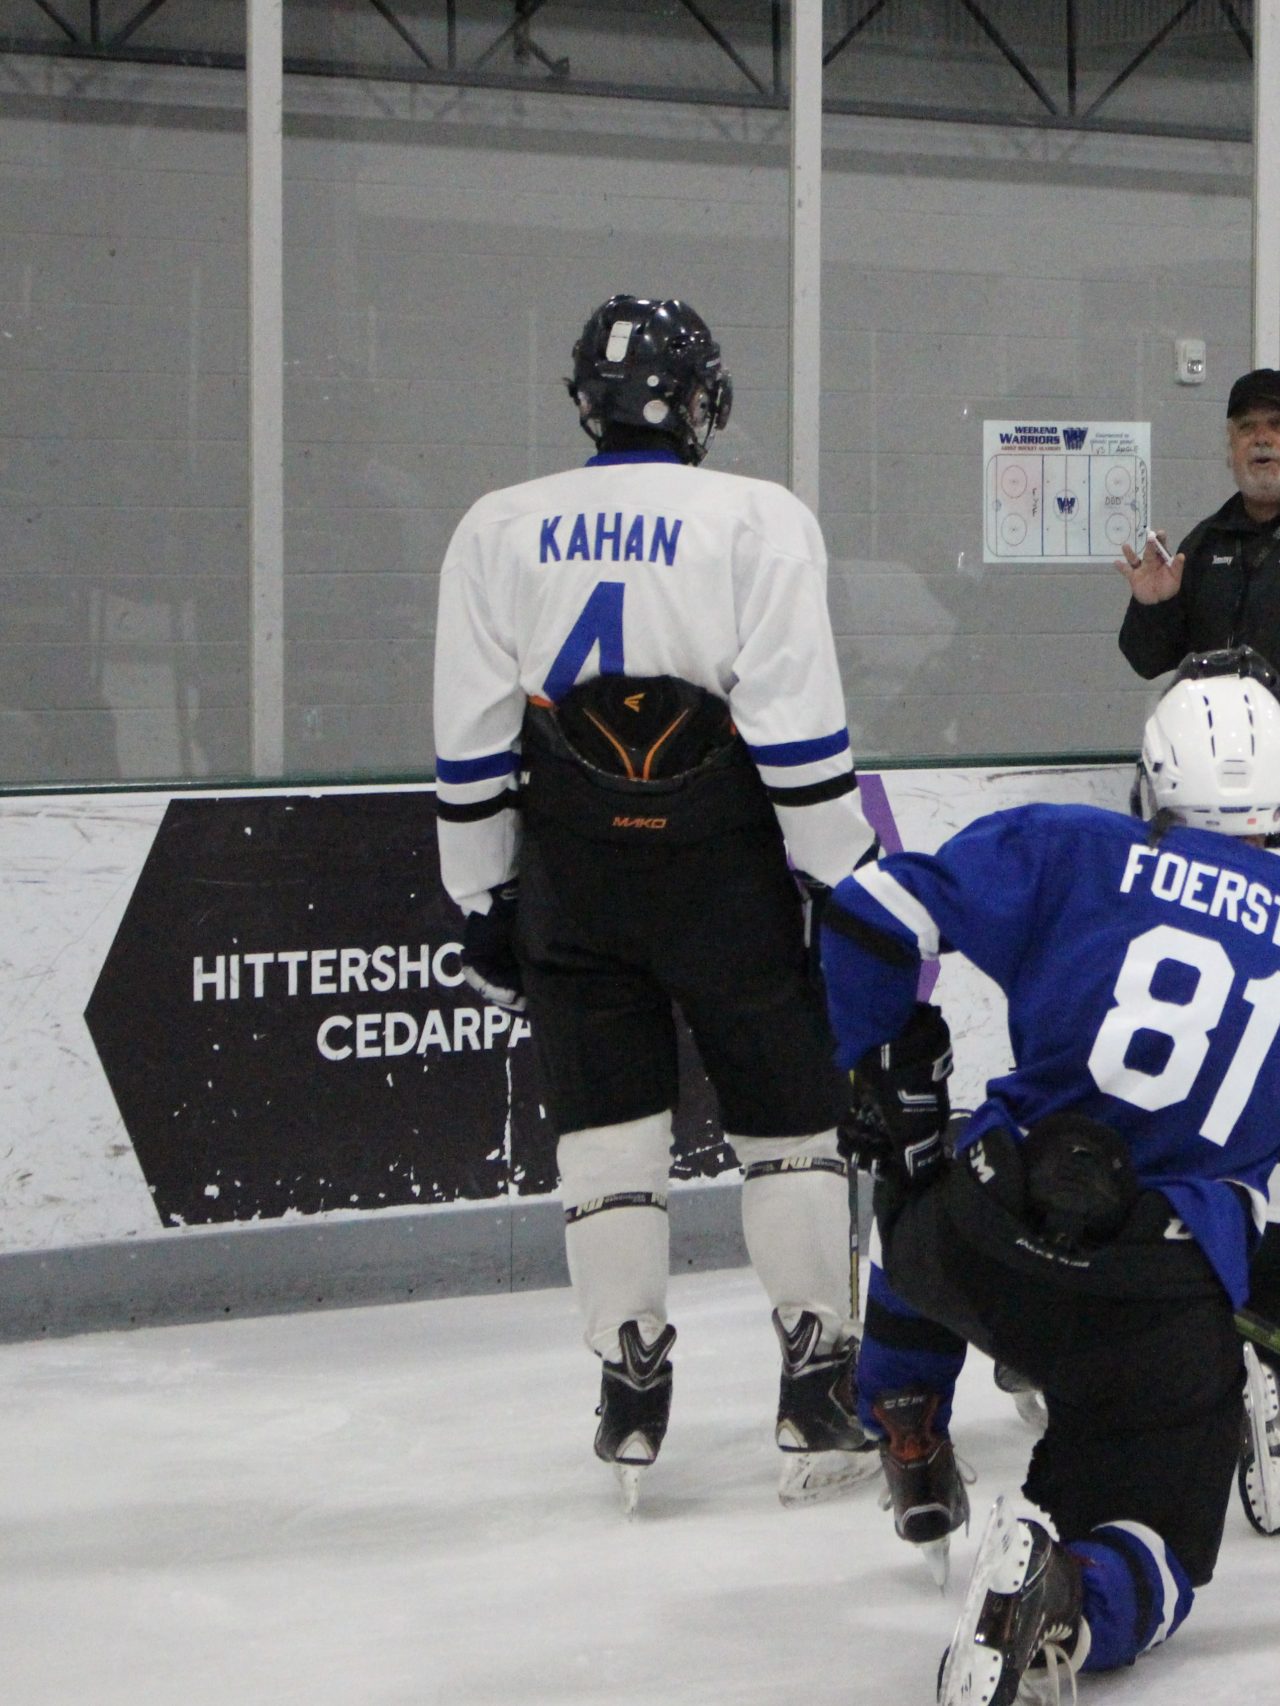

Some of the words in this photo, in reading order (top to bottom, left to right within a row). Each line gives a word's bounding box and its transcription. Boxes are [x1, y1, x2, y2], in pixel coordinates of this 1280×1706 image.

[1015, 426, 1057, 434] WEEKEND
[999, 433, 1060, 445] WARRIORS
[539, 512, 683, 567] KAHAN
[612, 816, 668, 829] MAKO
